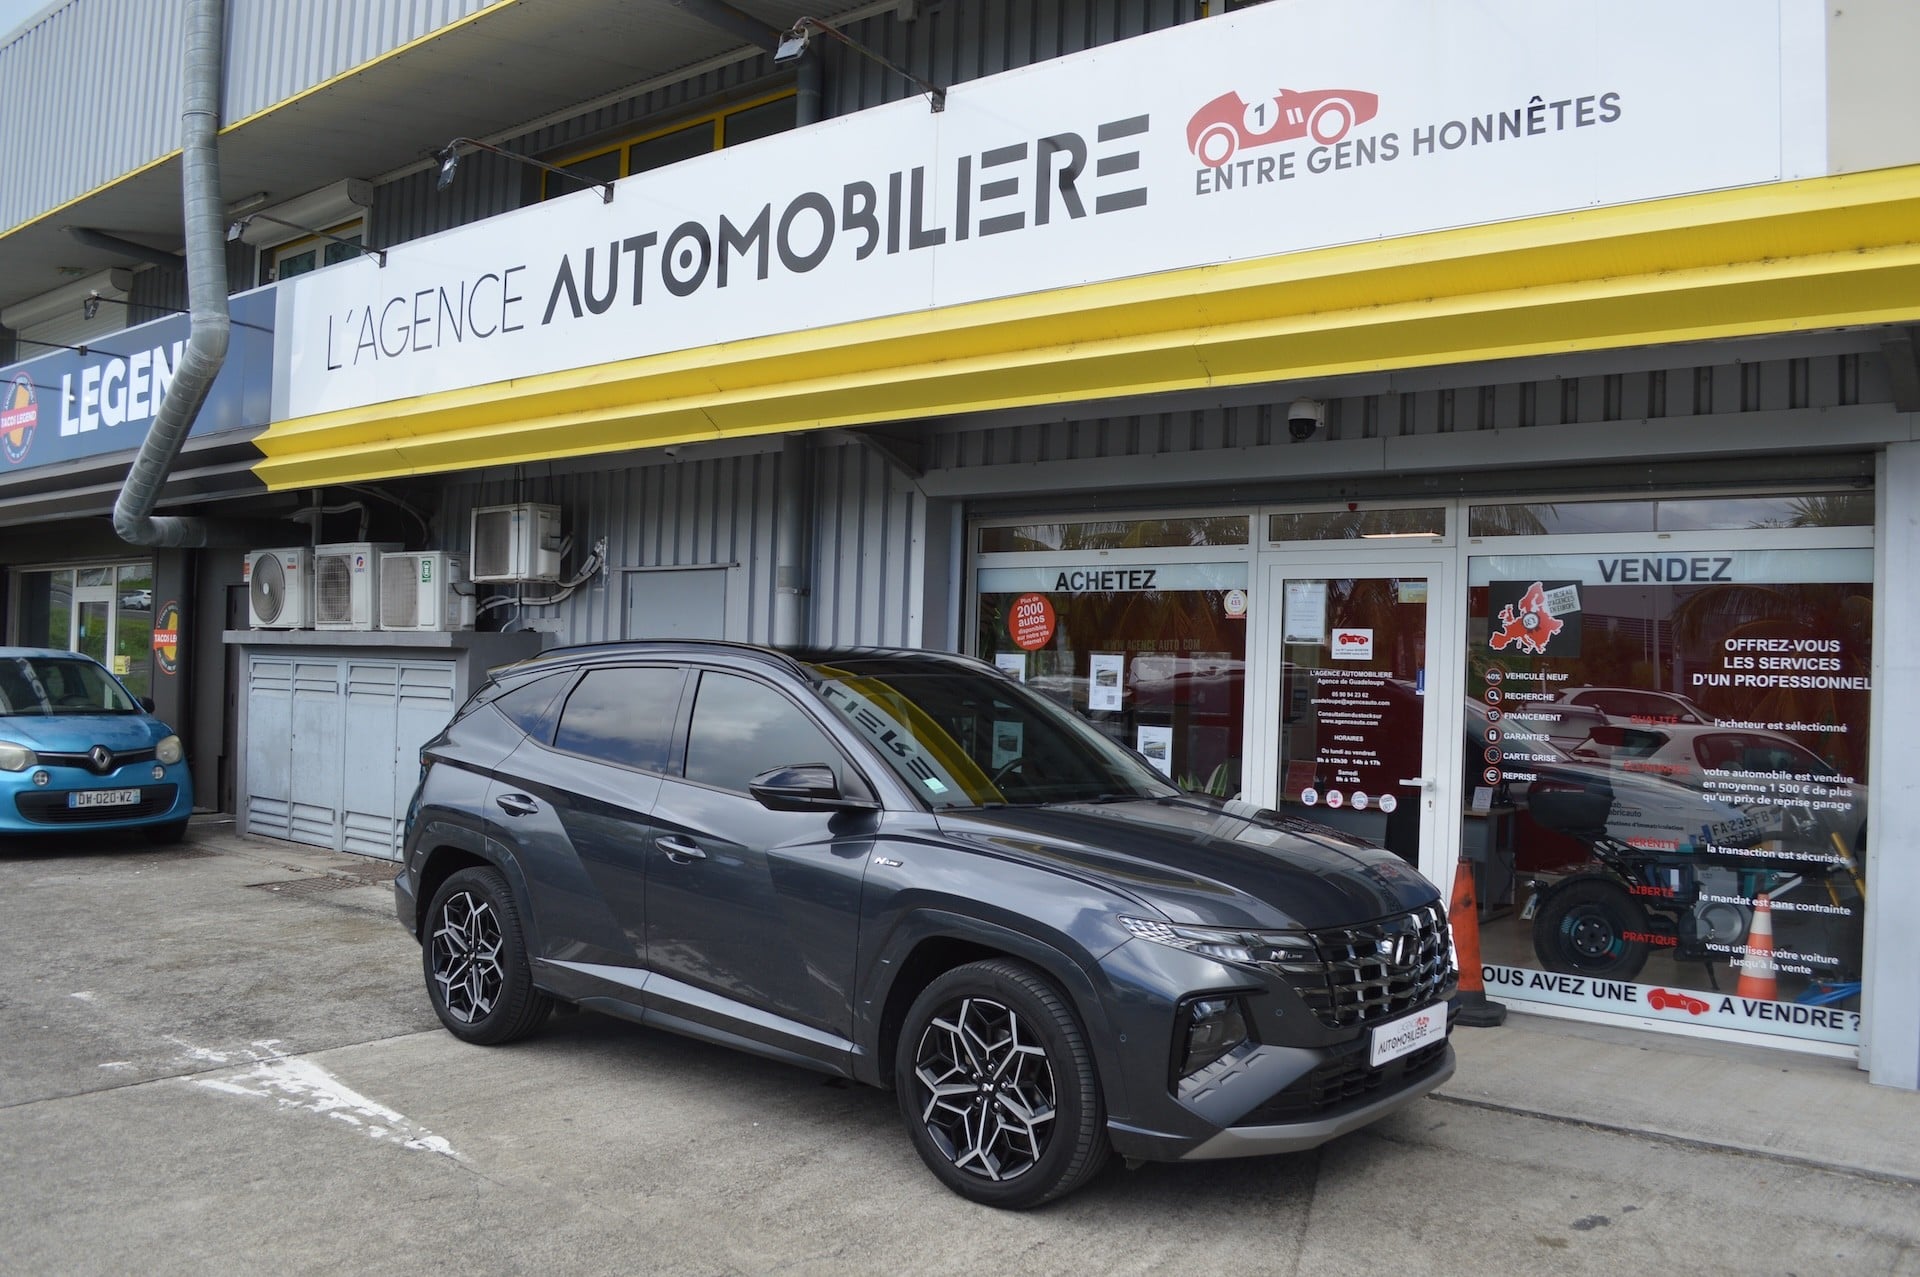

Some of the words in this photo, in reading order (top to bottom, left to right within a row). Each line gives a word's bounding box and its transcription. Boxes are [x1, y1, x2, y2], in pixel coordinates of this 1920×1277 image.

[1254, 103, 1265, 126] 1
[1196, 151, 1296, 196] ENTRE
[1307, 132, 1399, 174] GENS
[1413, 92, 1623, 156] HONNÊTES
[327, 265, 527, 371] L'AGENCE
[541, 114, 1150, 325] AUTOMOBILIERE
[60, 339, 190, 437] LEGEN
[17, 410, 37, 424] LEGEND
[1598, 558, 1732, 582] VENDEZ
[1055, 570, 1156, 591] ACHETEZ
[1017, 601, 1044, 618] 2000
[1018, 614, 1045, 627] autos
[154, 634, 169, 643] TACOS
[1725, 638, 1841, 653] OFFREZ-VOUS
[1724, 657, 1754, 669] LES
[1759, 657, 1841, 671] SERVICES
[1693, 673, 1730, 687] D'UN
[1735, 675, 1872, 690] PROFESSIONNEL
[1504, 693, 1555, 701] RECHERCHE
[1504, 712, 1562, 721] FINANCEMENT
[1714, 718, 1765, 730] l'acheteur
[1767, 722, 1784, 731] est
[1785, 721, 1847, 733] sélectionné
[1503, 733, 1550, 742] GARANTIES
[1503, 752, 1530, 760] CARTE
[1532, 754, 1557, 762] GRISE
[1502, 772, 1537, 781] REPRISE
[1703, 768, 1730, 777] votre
[1732, 769, 1793, 781] automobile
[1794, 773, 1811, 782] est
[1813, 773, 1854, 784] vendue
[1718, 782, 1766, 793] moyenne
[1779, 784, 1800, 794] 500
[1802, 785, 1810, 794] €
[1812, 785, 1826, 795] de
[1829, 786, 1852, 798] plus
[1703, 793, 1732, 804] qu'un
[1734, 794, 1755, 806] prix
[1757, 795, 1771, 805] de
[1773, 796, 1810, 809] reprise
[1812, 801, 1852, 812] garage
[1707, 843, 1717, 853] la
[1718, 845, 1775, 858] transaction
[1778, 850, 1794, 860] est
[1796, 851, 1849, 864] sécurisée
[1629, 885, 1675, 897] LIBERTÉ
[1698, 891, 1709, 901] le
[1710, 896, 1750, 906] mandat
[1752, 898, 1768, 907] est
[1770, 901, 1794, 910] sans
[1796, 902, 1851, 916] contrainte
[1622, 931, 1678, 946] PRATIQUE
[1705, 943, 1730, 953] vous
[1732, 944, 1768, 956] utilisez
[1801, 952, 1839, 965] voiture
[1729, 956, 1767, 969] jusqu'à
[1769, 961, 1780, 971] la
[1781, 965, 1812, 975] vente
[1481, 966, 1524, 986] OUS
[1530, 973, 1585, 995] AVEZ
[1592, 981, 1637, 1002] UNE
[1719, 997, 1735, 1015] A
[1742, 999, 1844, 1030] VENDRE
[1849, 1013, 1861, 1032] ?
